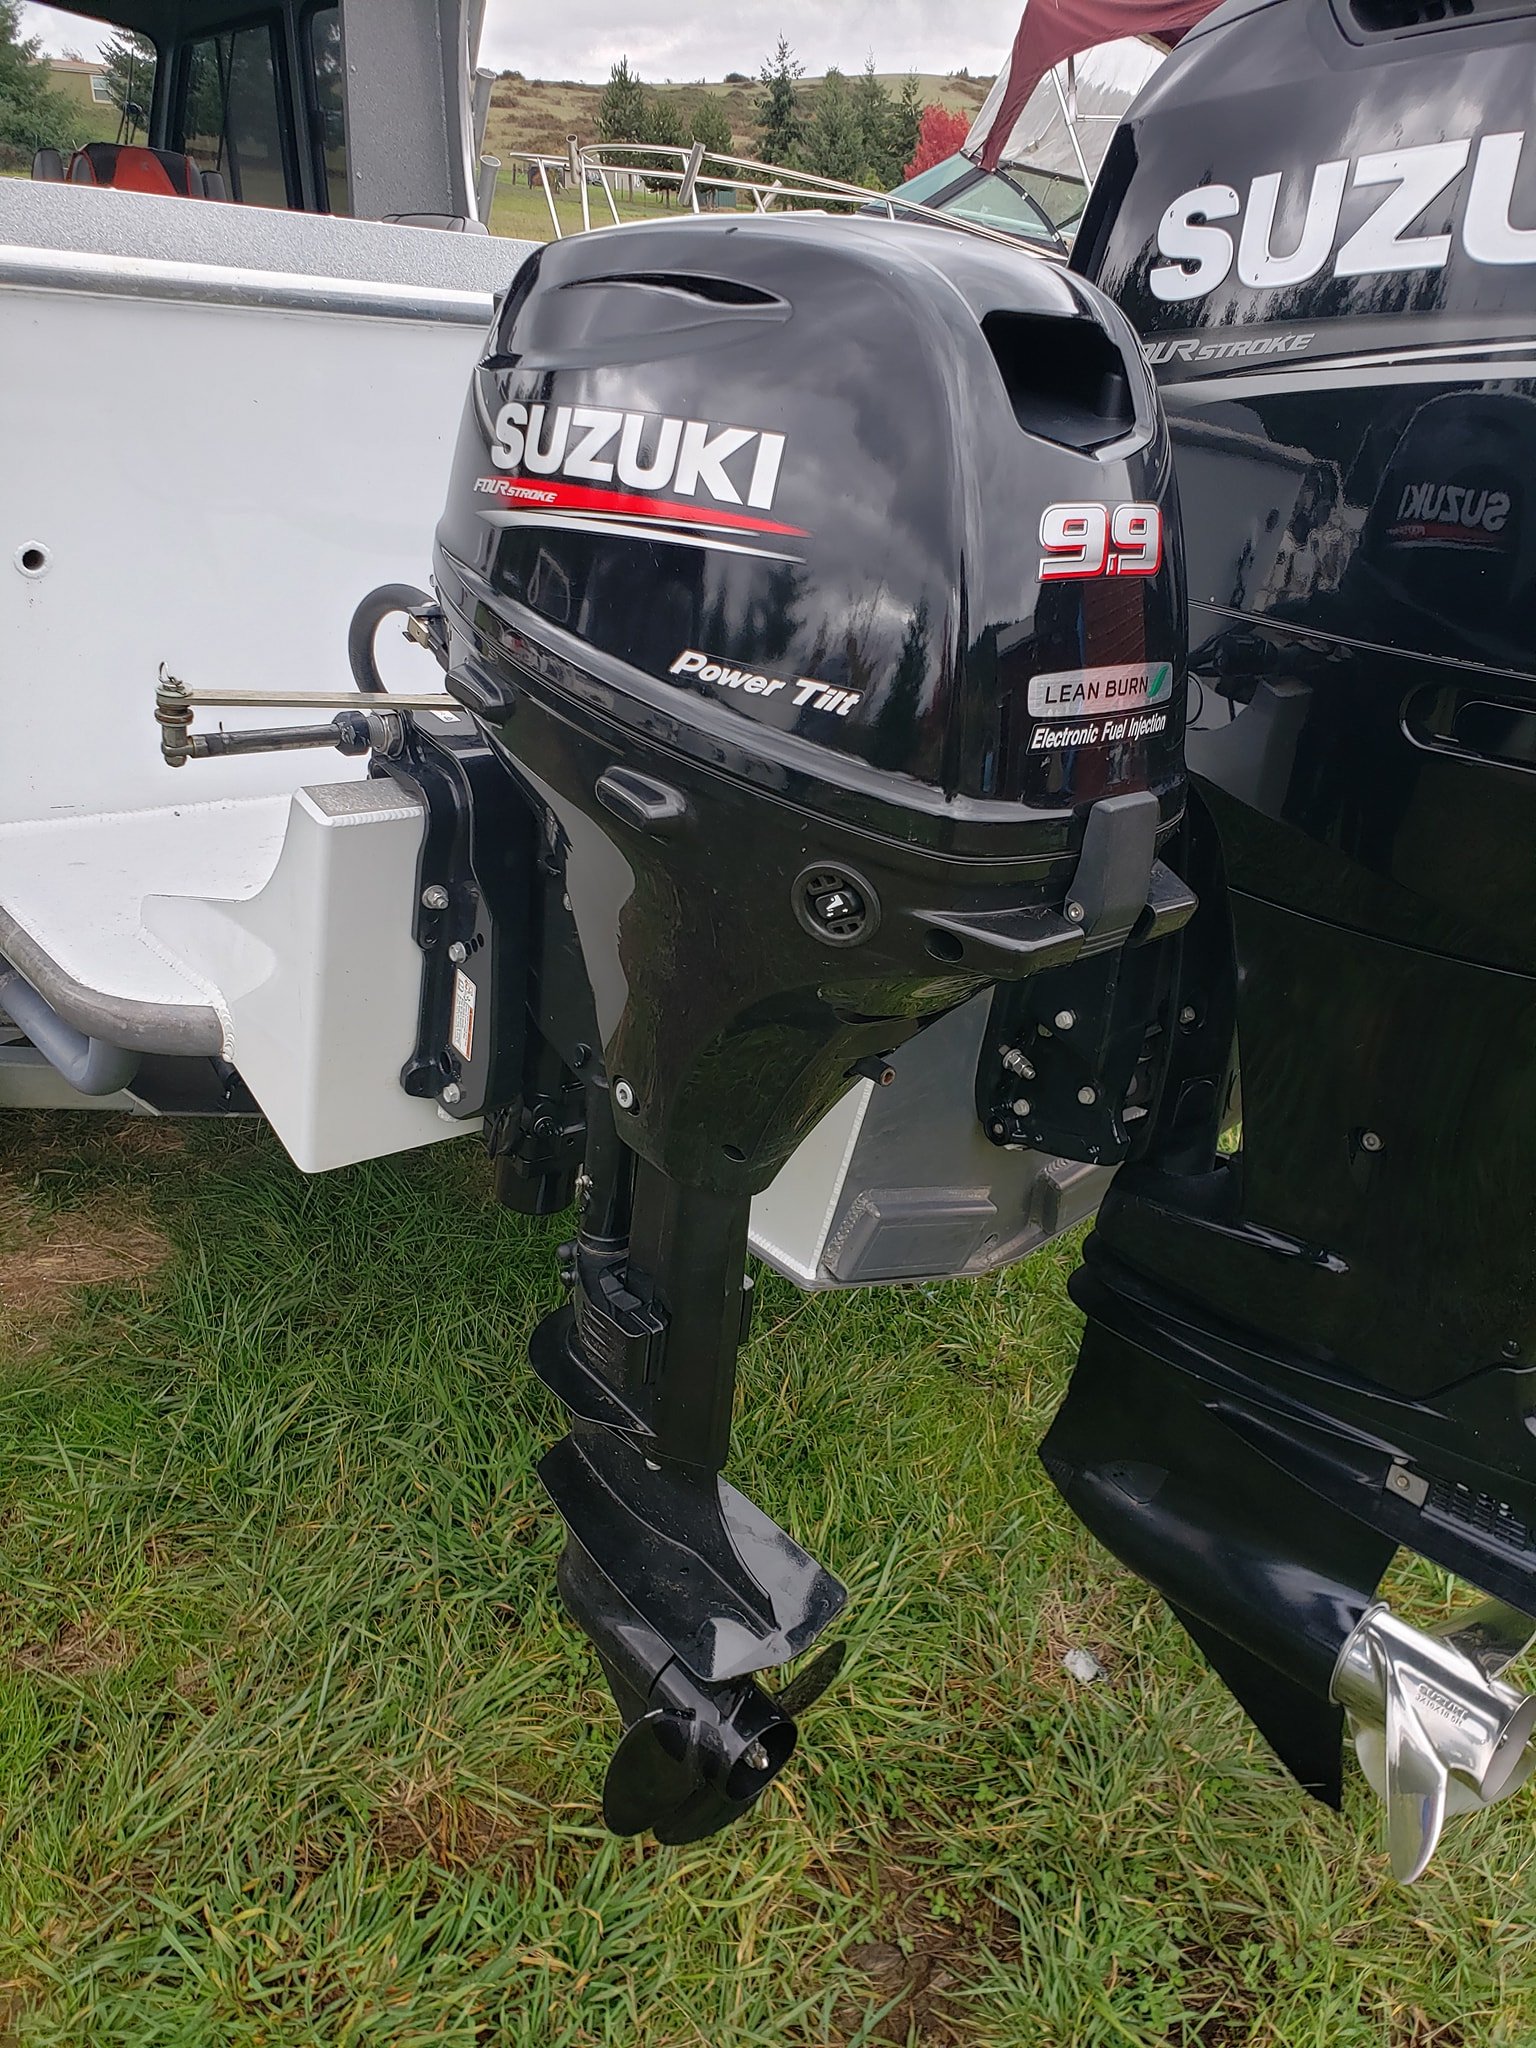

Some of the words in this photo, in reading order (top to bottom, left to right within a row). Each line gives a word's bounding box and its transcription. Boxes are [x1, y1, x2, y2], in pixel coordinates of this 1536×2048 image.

[490, 402, 786, 510] SUZUKI
[1039, 503, 1163, 580] 9.9
[670, 649, 786, 697] Power
[791, 678, 862, 716] Tilt
[1045, 682, 1099, 704] LEAN
[1105, 676, 1149, 698] BURN
[1031, 724, 1099, 749] Electronic
[1102, 720, 1126, 742] Fuel
[1129, 714, 1167, 741] Injection
